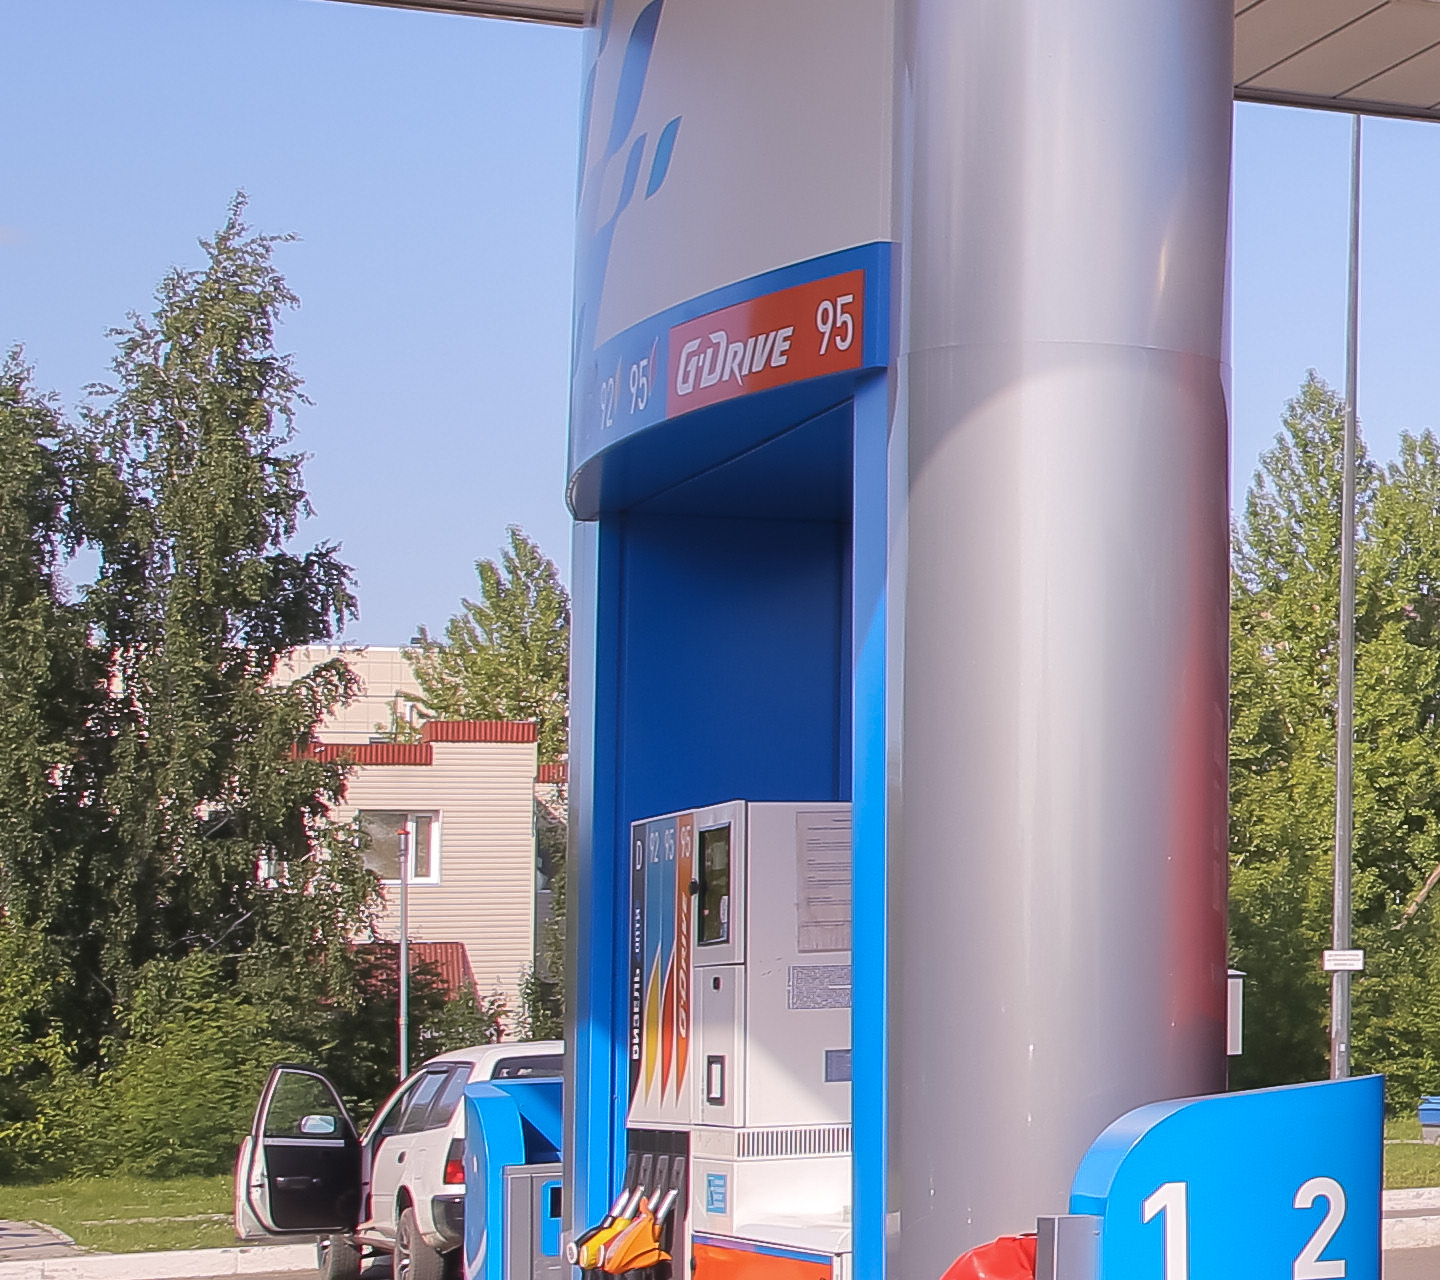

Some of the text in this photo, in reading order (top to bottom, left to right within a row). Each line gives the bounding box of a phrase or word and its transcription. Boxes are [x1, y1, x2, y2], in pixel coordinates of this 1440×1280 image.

[629, 358, 649, 414] 95
[816, 294, 854, 355] 95
[636, 826, 690, 870] D 92 95 95
[1293, 1177, 1347, 1280] 2
